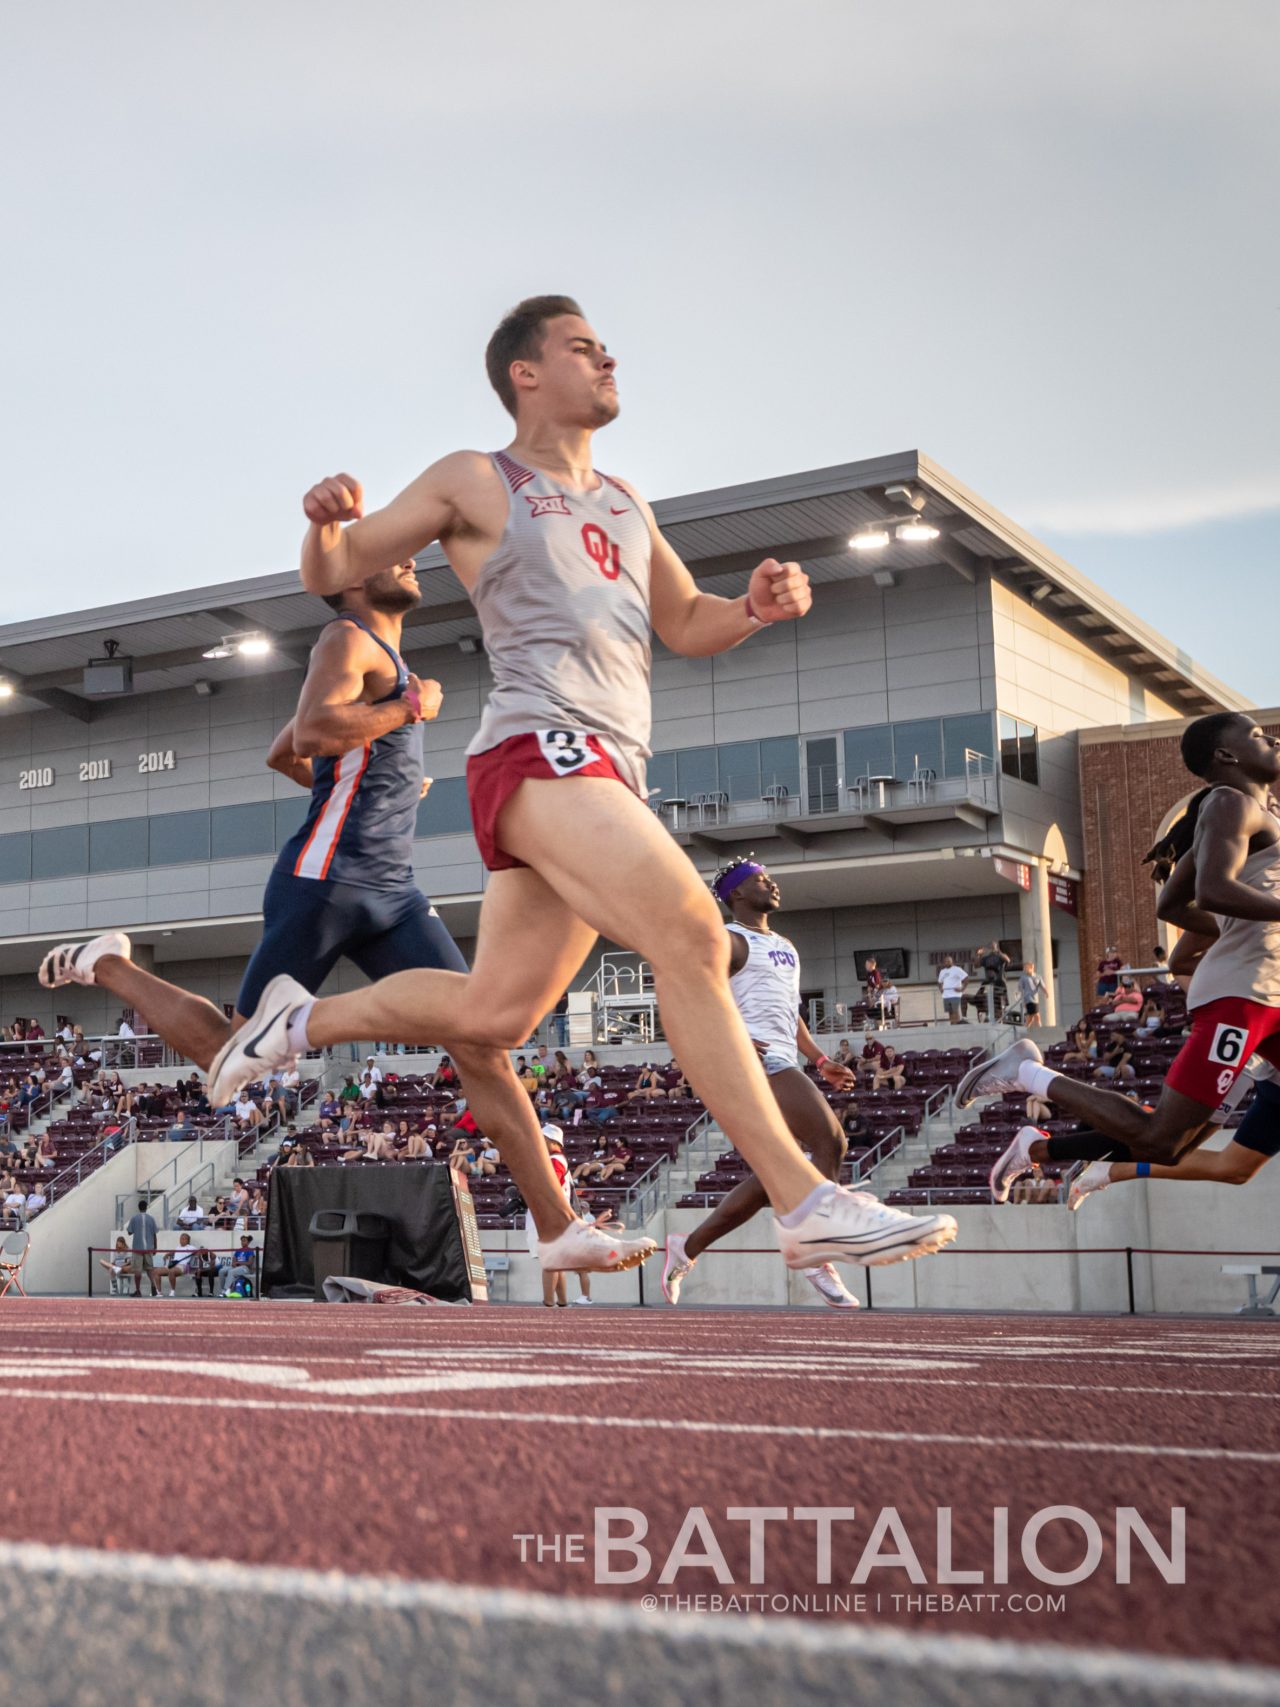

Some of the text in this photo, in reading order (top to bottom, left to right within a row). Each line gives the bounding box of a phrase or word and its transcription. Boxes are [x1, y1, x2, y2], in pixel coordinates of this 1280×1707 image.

[581, 522, 620, 580] OU
[547, 730, 585, 769] 3
[19, 767, 53, 790] 2010
[79, 759, 111, 782] 2011
[138, 750, 175, 774] 2014
[768, 950, 795, 968] TCU
[1217, 1029, 1242, 1061] 6
[1217, 1069, 1233, 1094] OU
